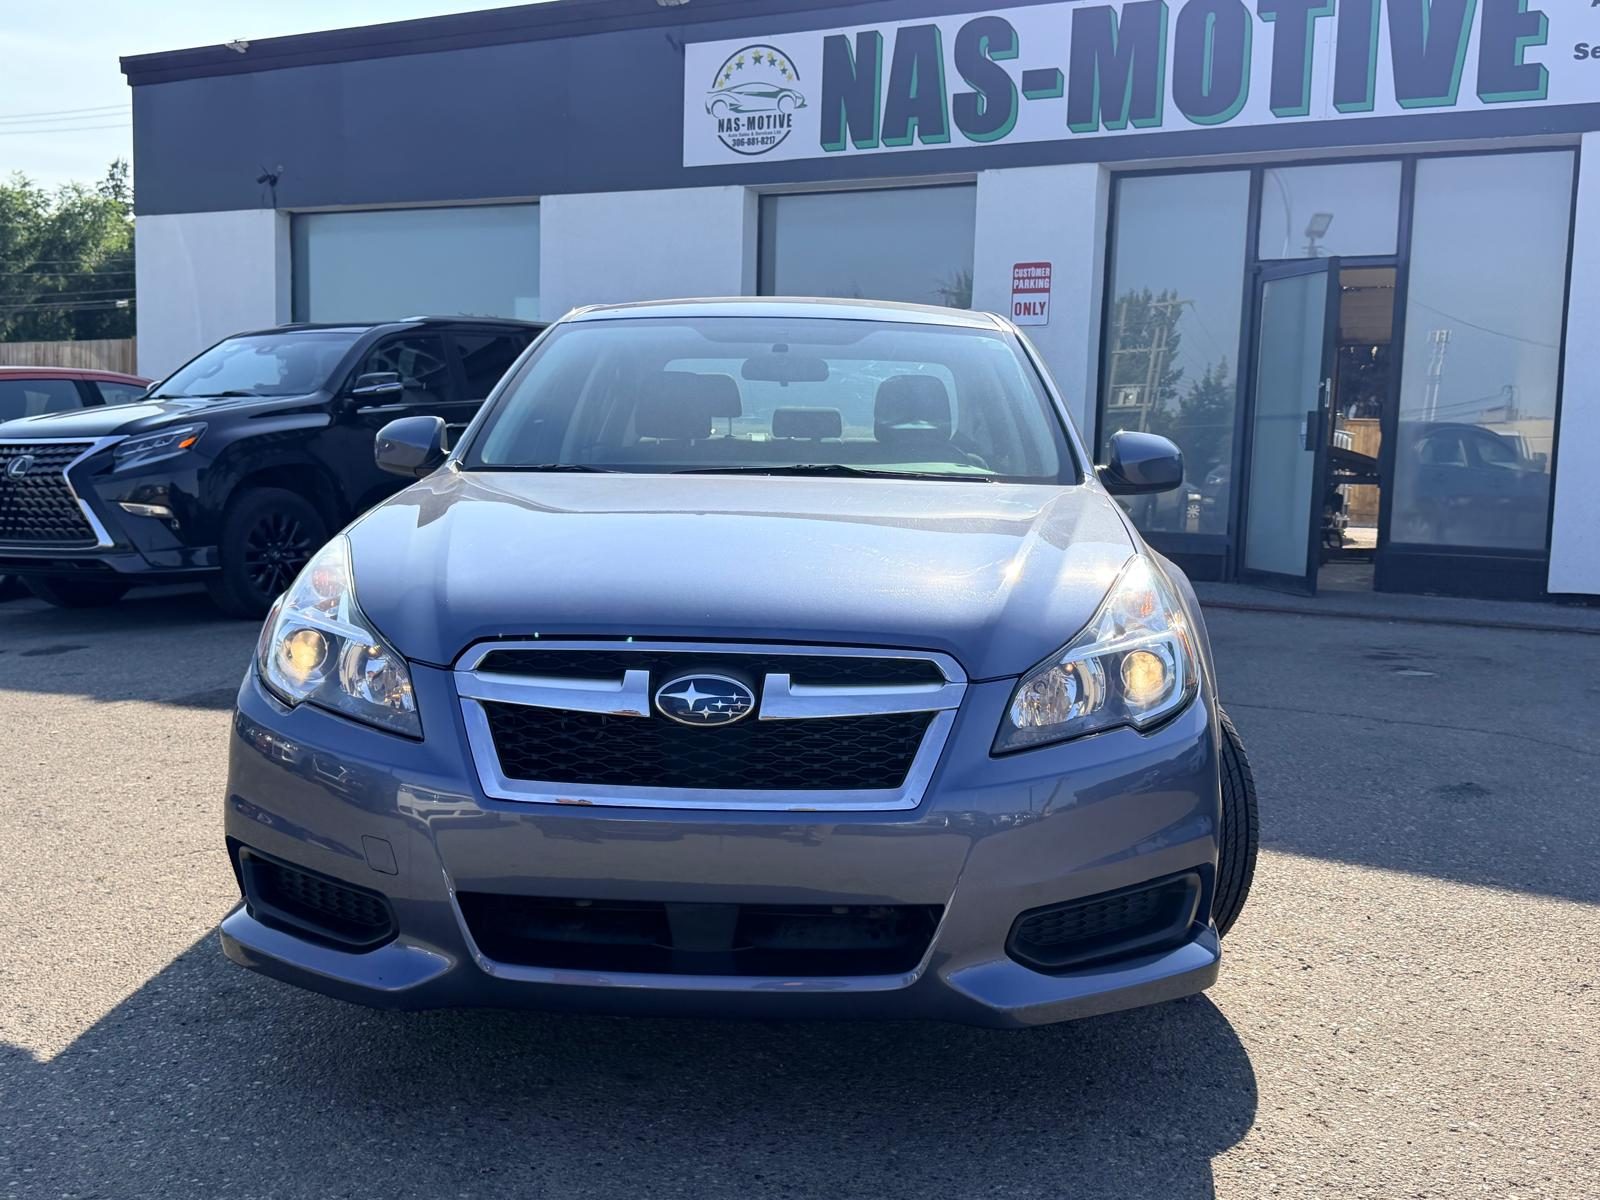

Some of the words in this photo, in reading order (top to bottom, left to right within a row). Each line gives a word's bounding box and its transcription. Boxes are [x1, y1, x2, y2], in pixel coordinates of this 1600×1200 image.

[820, 0, 1549, 152] NAS-MOTIVE
[718, 113, 792, 133] NAS-MOTIVE
[1014, 267, 1050, 278] CUSTOMER
[1013, 279, 1050, 289] PARKING
[1014, 301, 1046, 316] ONLY
